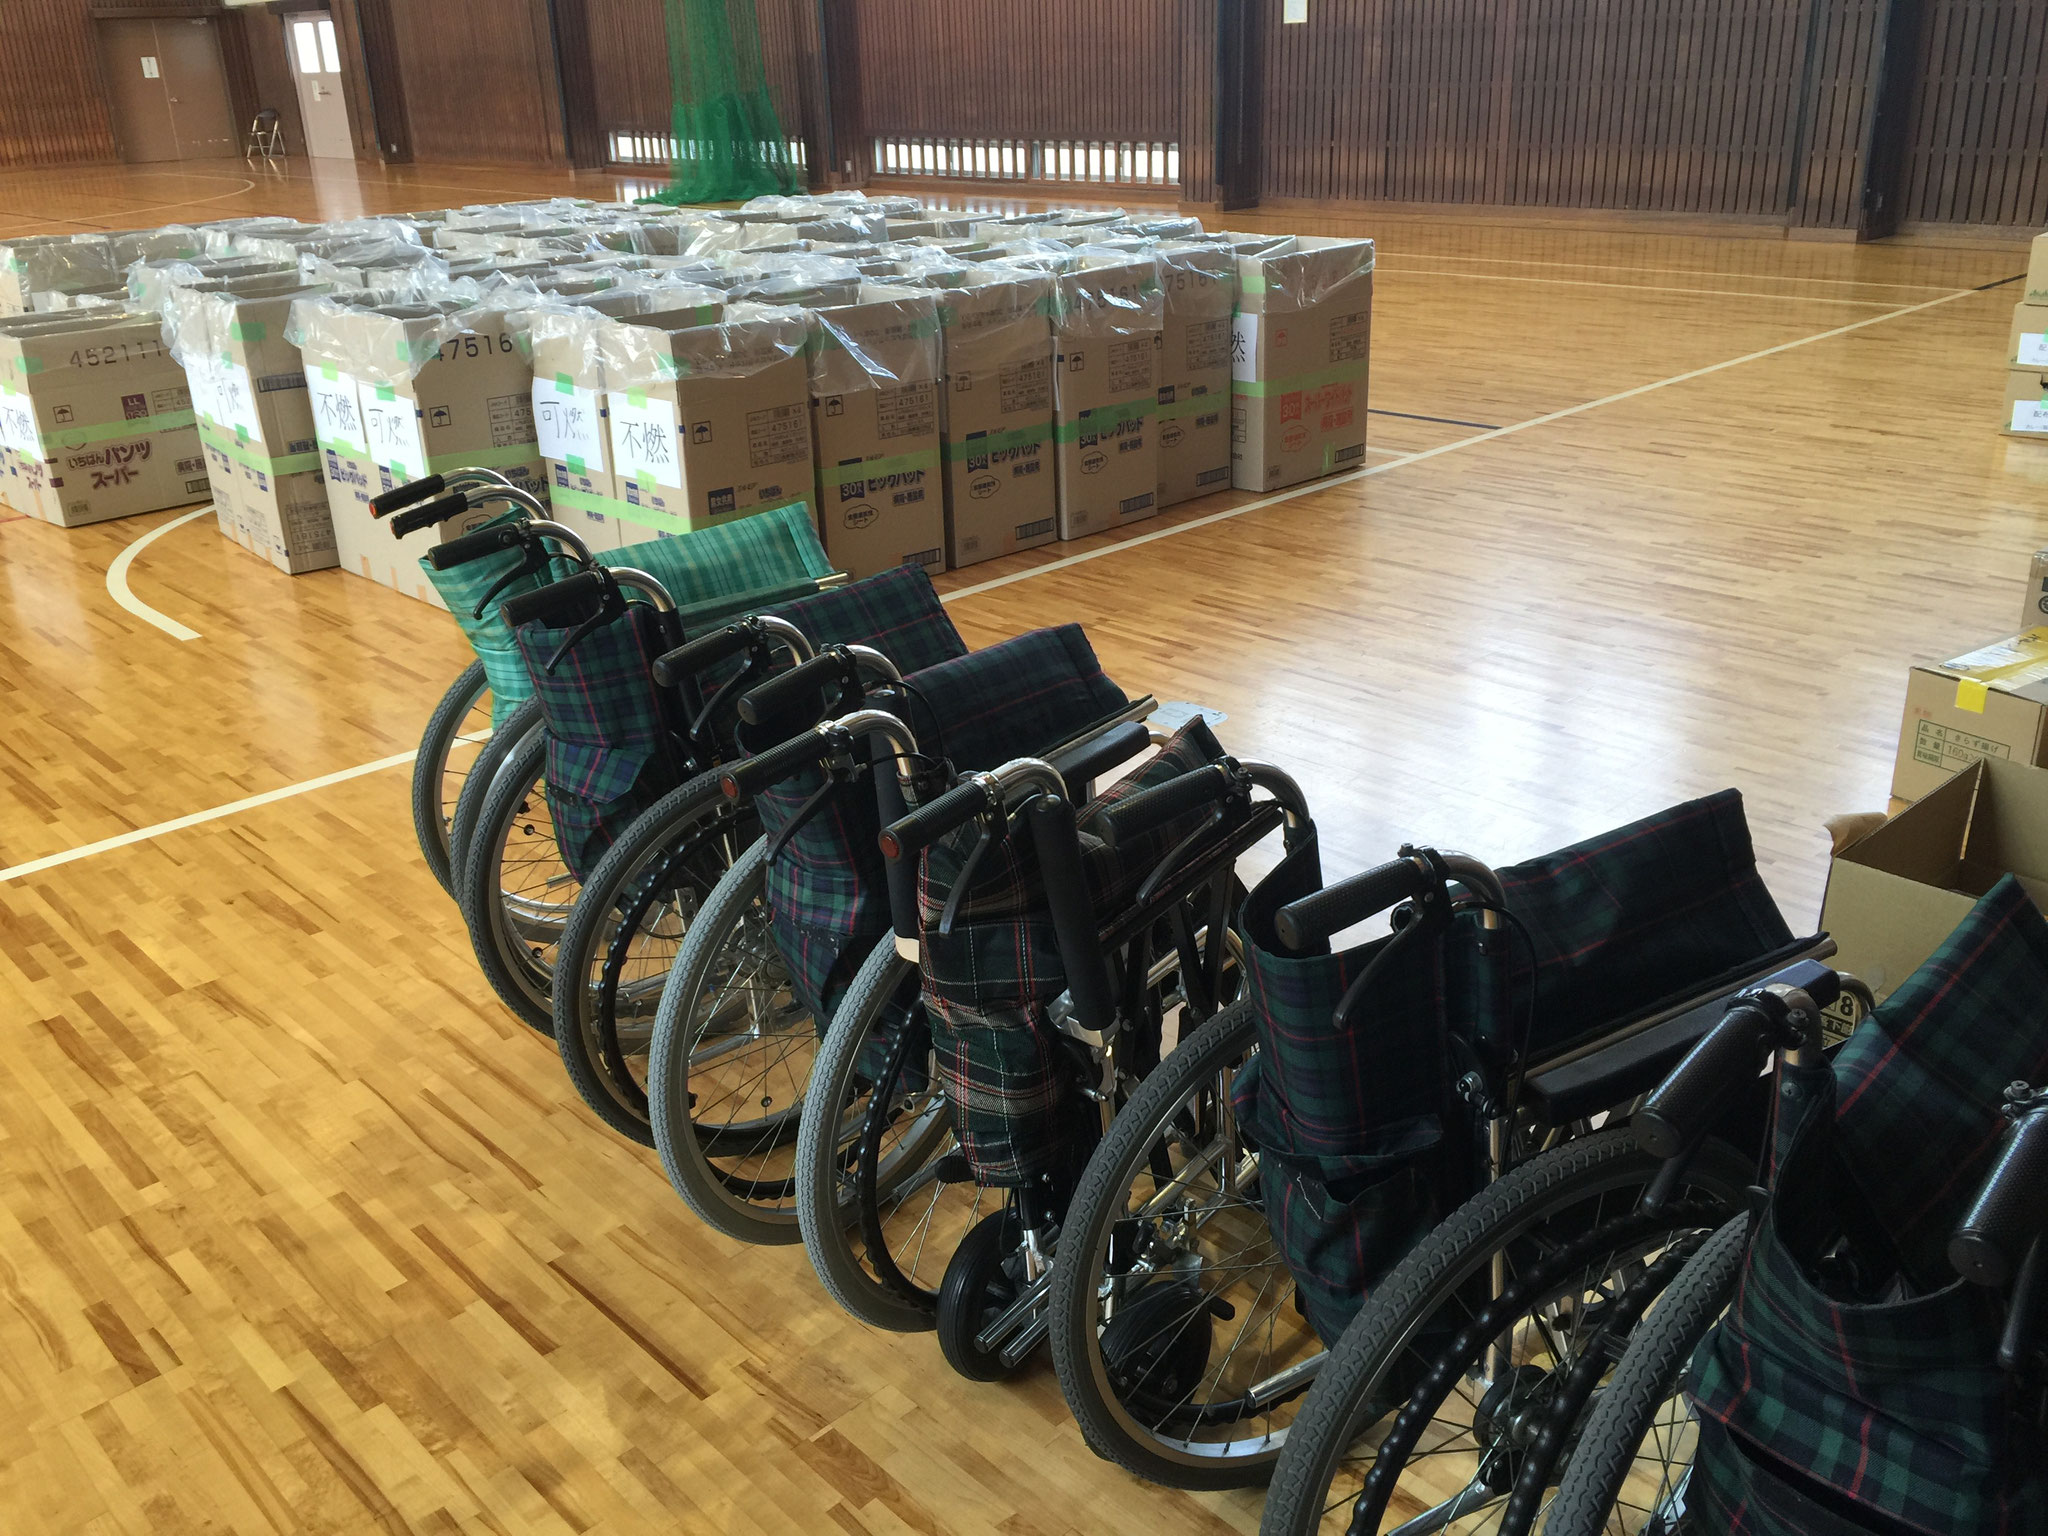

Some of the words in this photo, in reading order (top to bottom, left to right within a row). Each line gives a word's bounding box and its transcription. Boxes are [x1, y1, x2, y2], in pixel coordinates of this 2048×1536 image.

[70, 339, 162, 368] 452111
[127, 397, 140, 406] LL
[317, 391, 357, 431] 不燃
[3, 406, 36, 441] 不燃
[368, 408, 410, 447] 可燃
[539, 401, 590, 441] 可燃
[619, 421, 670, 464] 不燃
[90, 467, 139, 490] スーパー
